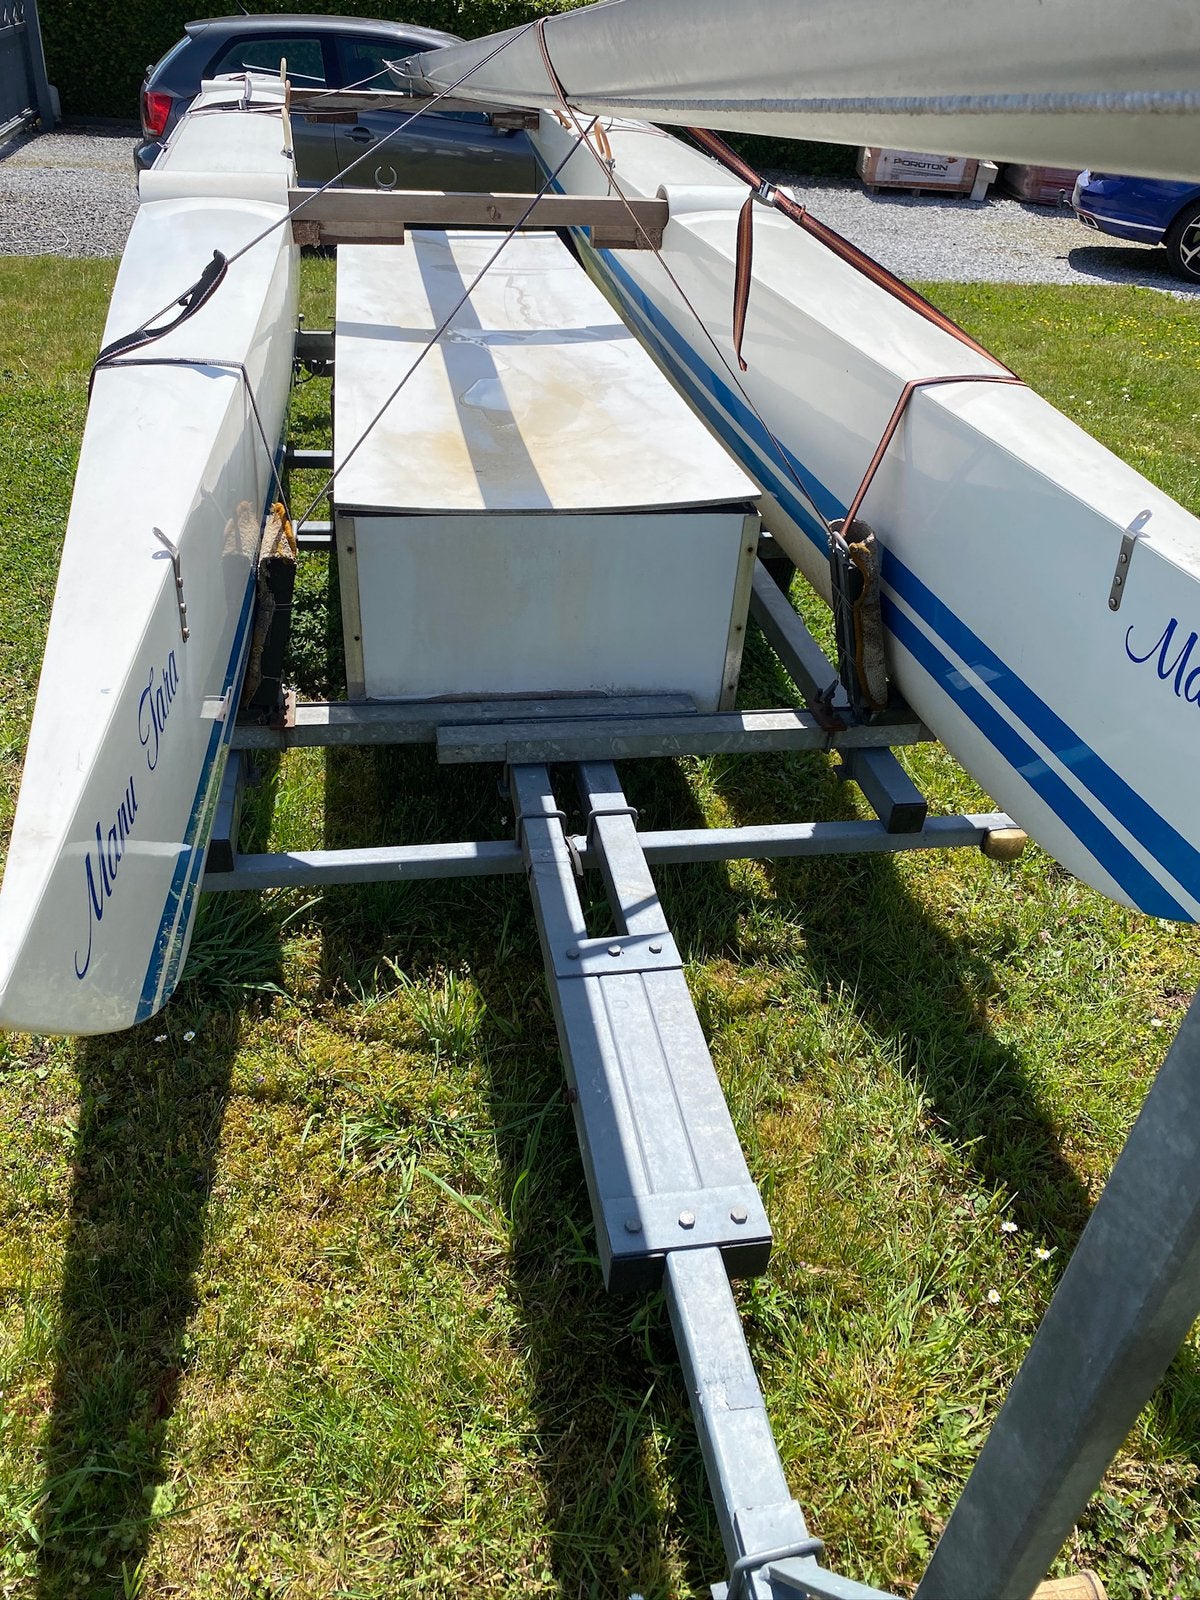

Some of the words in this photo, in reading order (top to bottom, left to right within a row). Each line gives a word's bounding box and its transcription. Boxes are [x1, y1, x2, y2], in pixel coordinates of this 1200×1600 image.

[894, 158, 948, 171] POROTON
[75, 776, 138, 979] Manu
[139, 650, 179, 771] Tara
